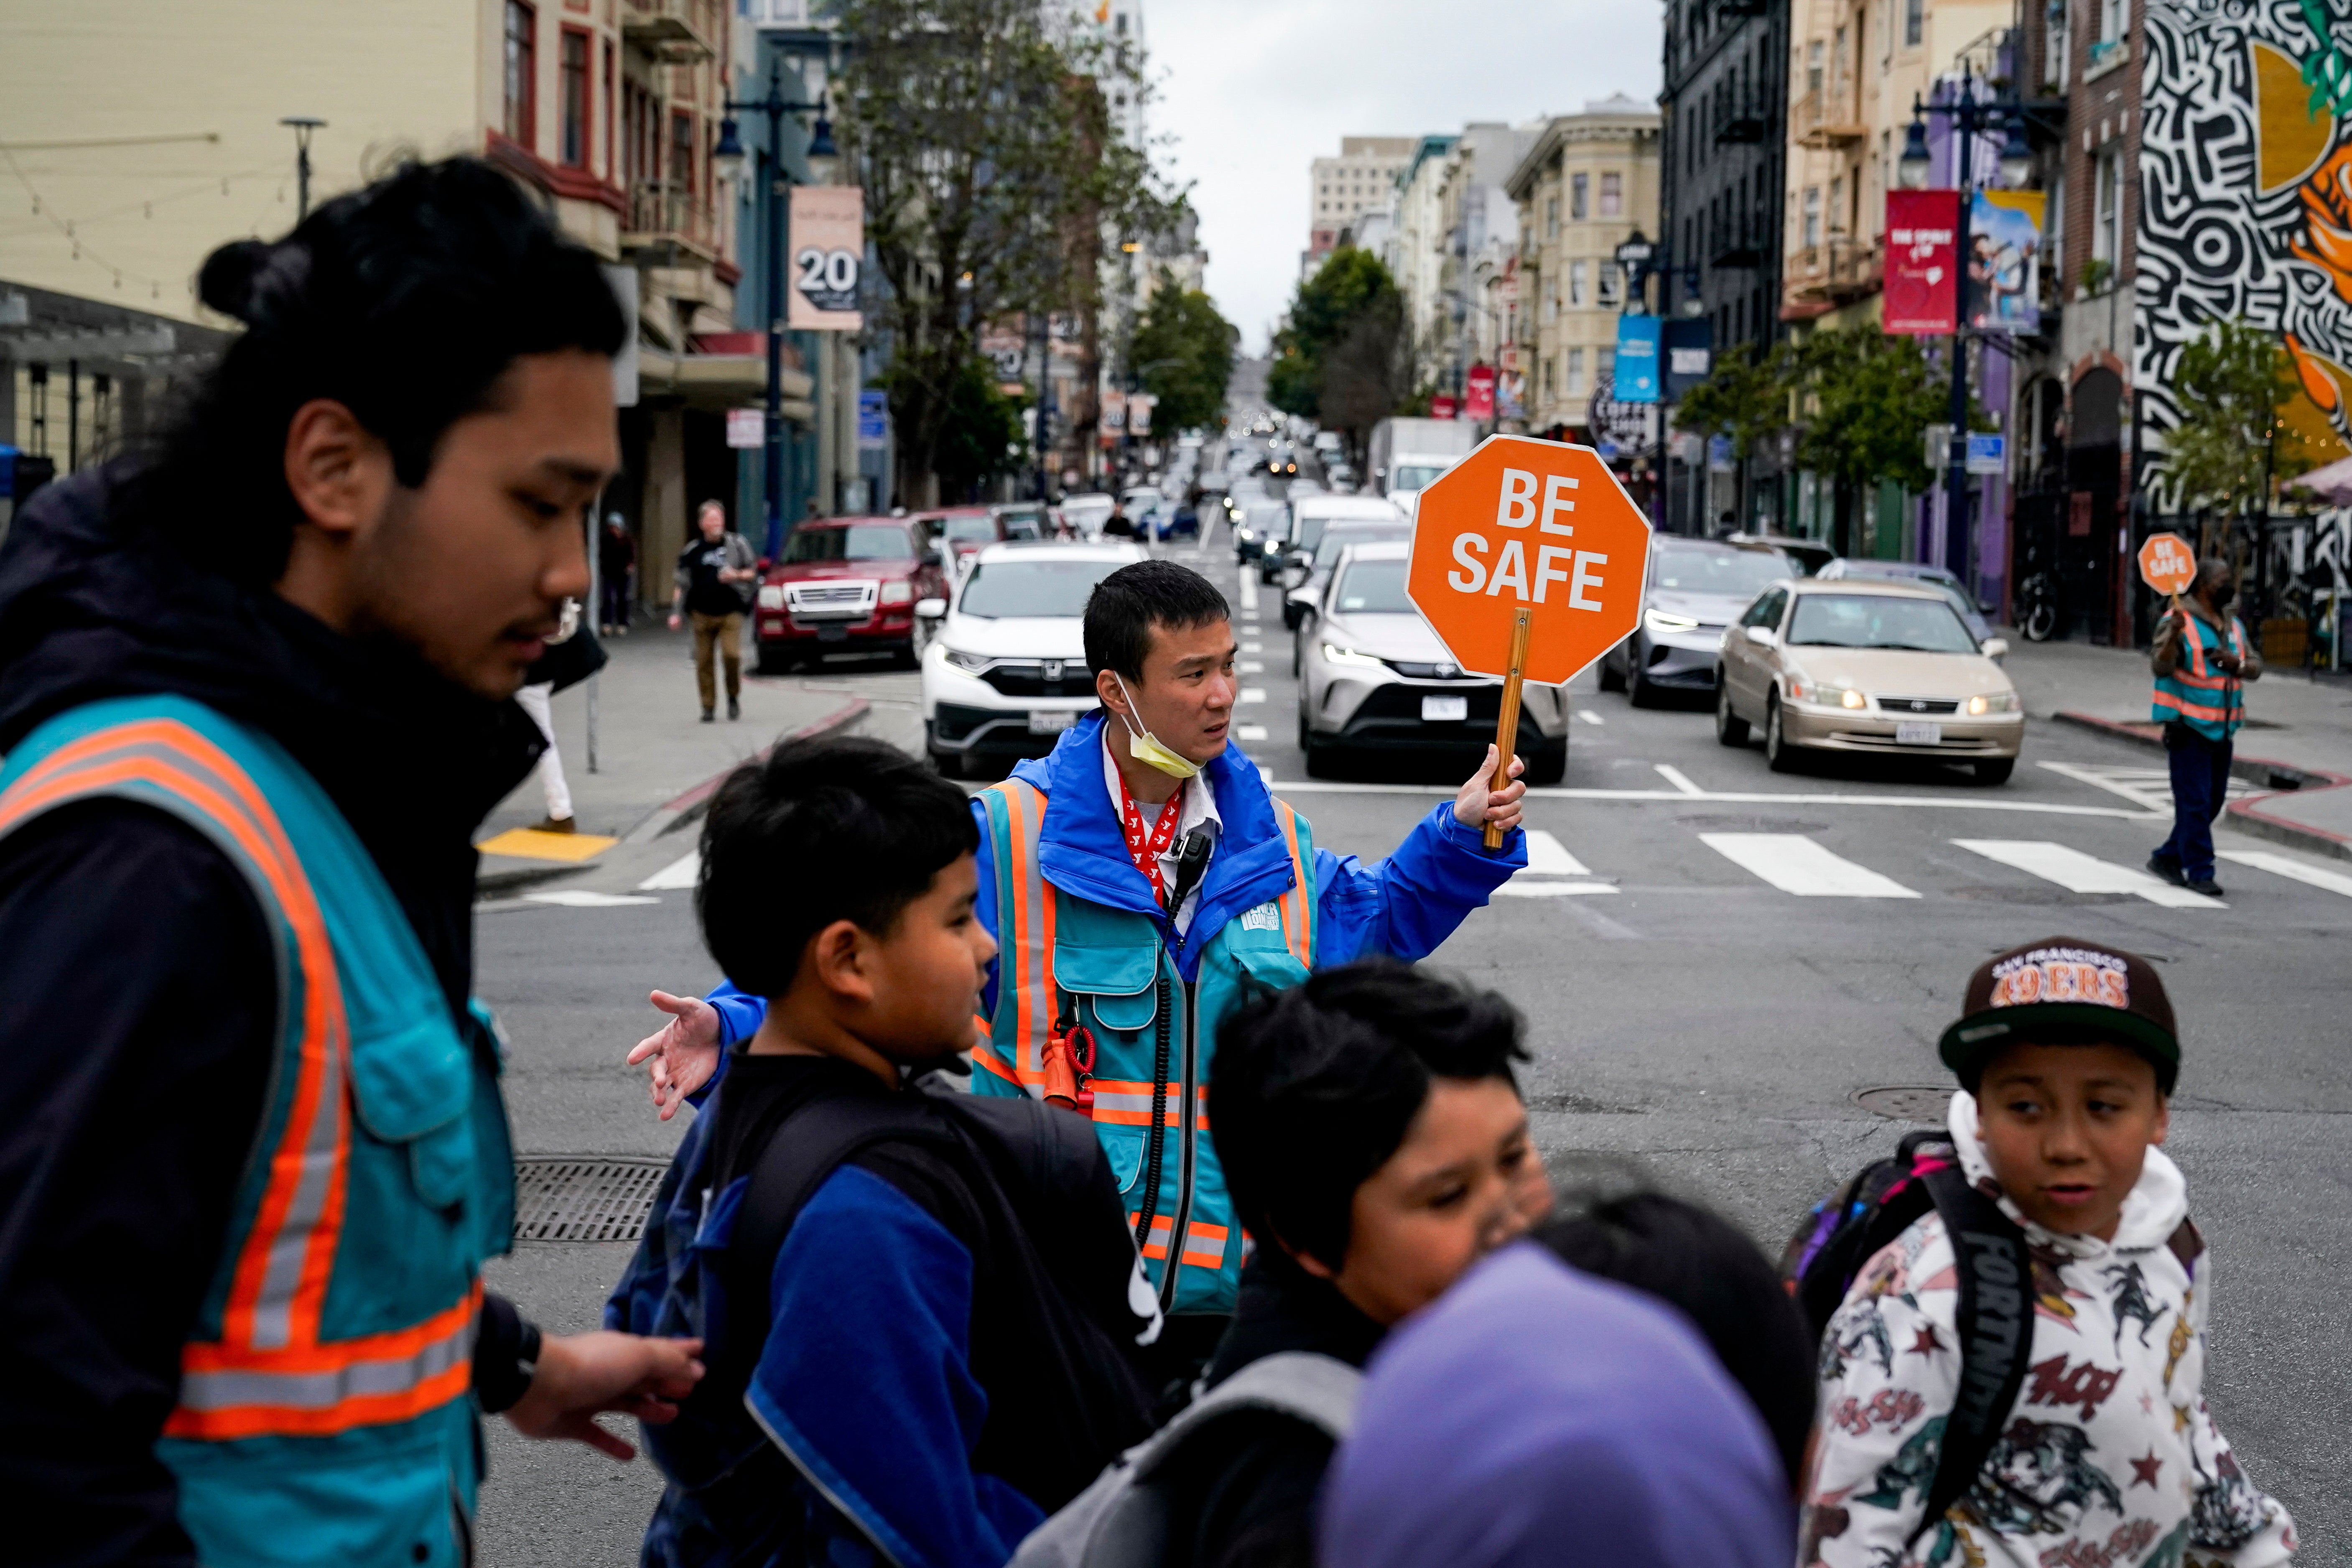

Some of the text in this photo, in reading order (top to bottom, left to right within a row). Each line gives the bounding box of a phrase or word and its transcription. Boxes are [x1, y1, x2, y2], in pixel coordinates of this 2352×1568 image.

[798, 248, 857, 292] 20
[1496, 468, 1579, 537] BE
[2149, 556, 2187, 577] SAFE
[2155, 540, 2175, 559] BE
[1448, 533, 1608, 612] SAFE
[2026, 947, 2127, 972] FRANCISCO
[1989, 961, 2130, 1010] 49ERS
